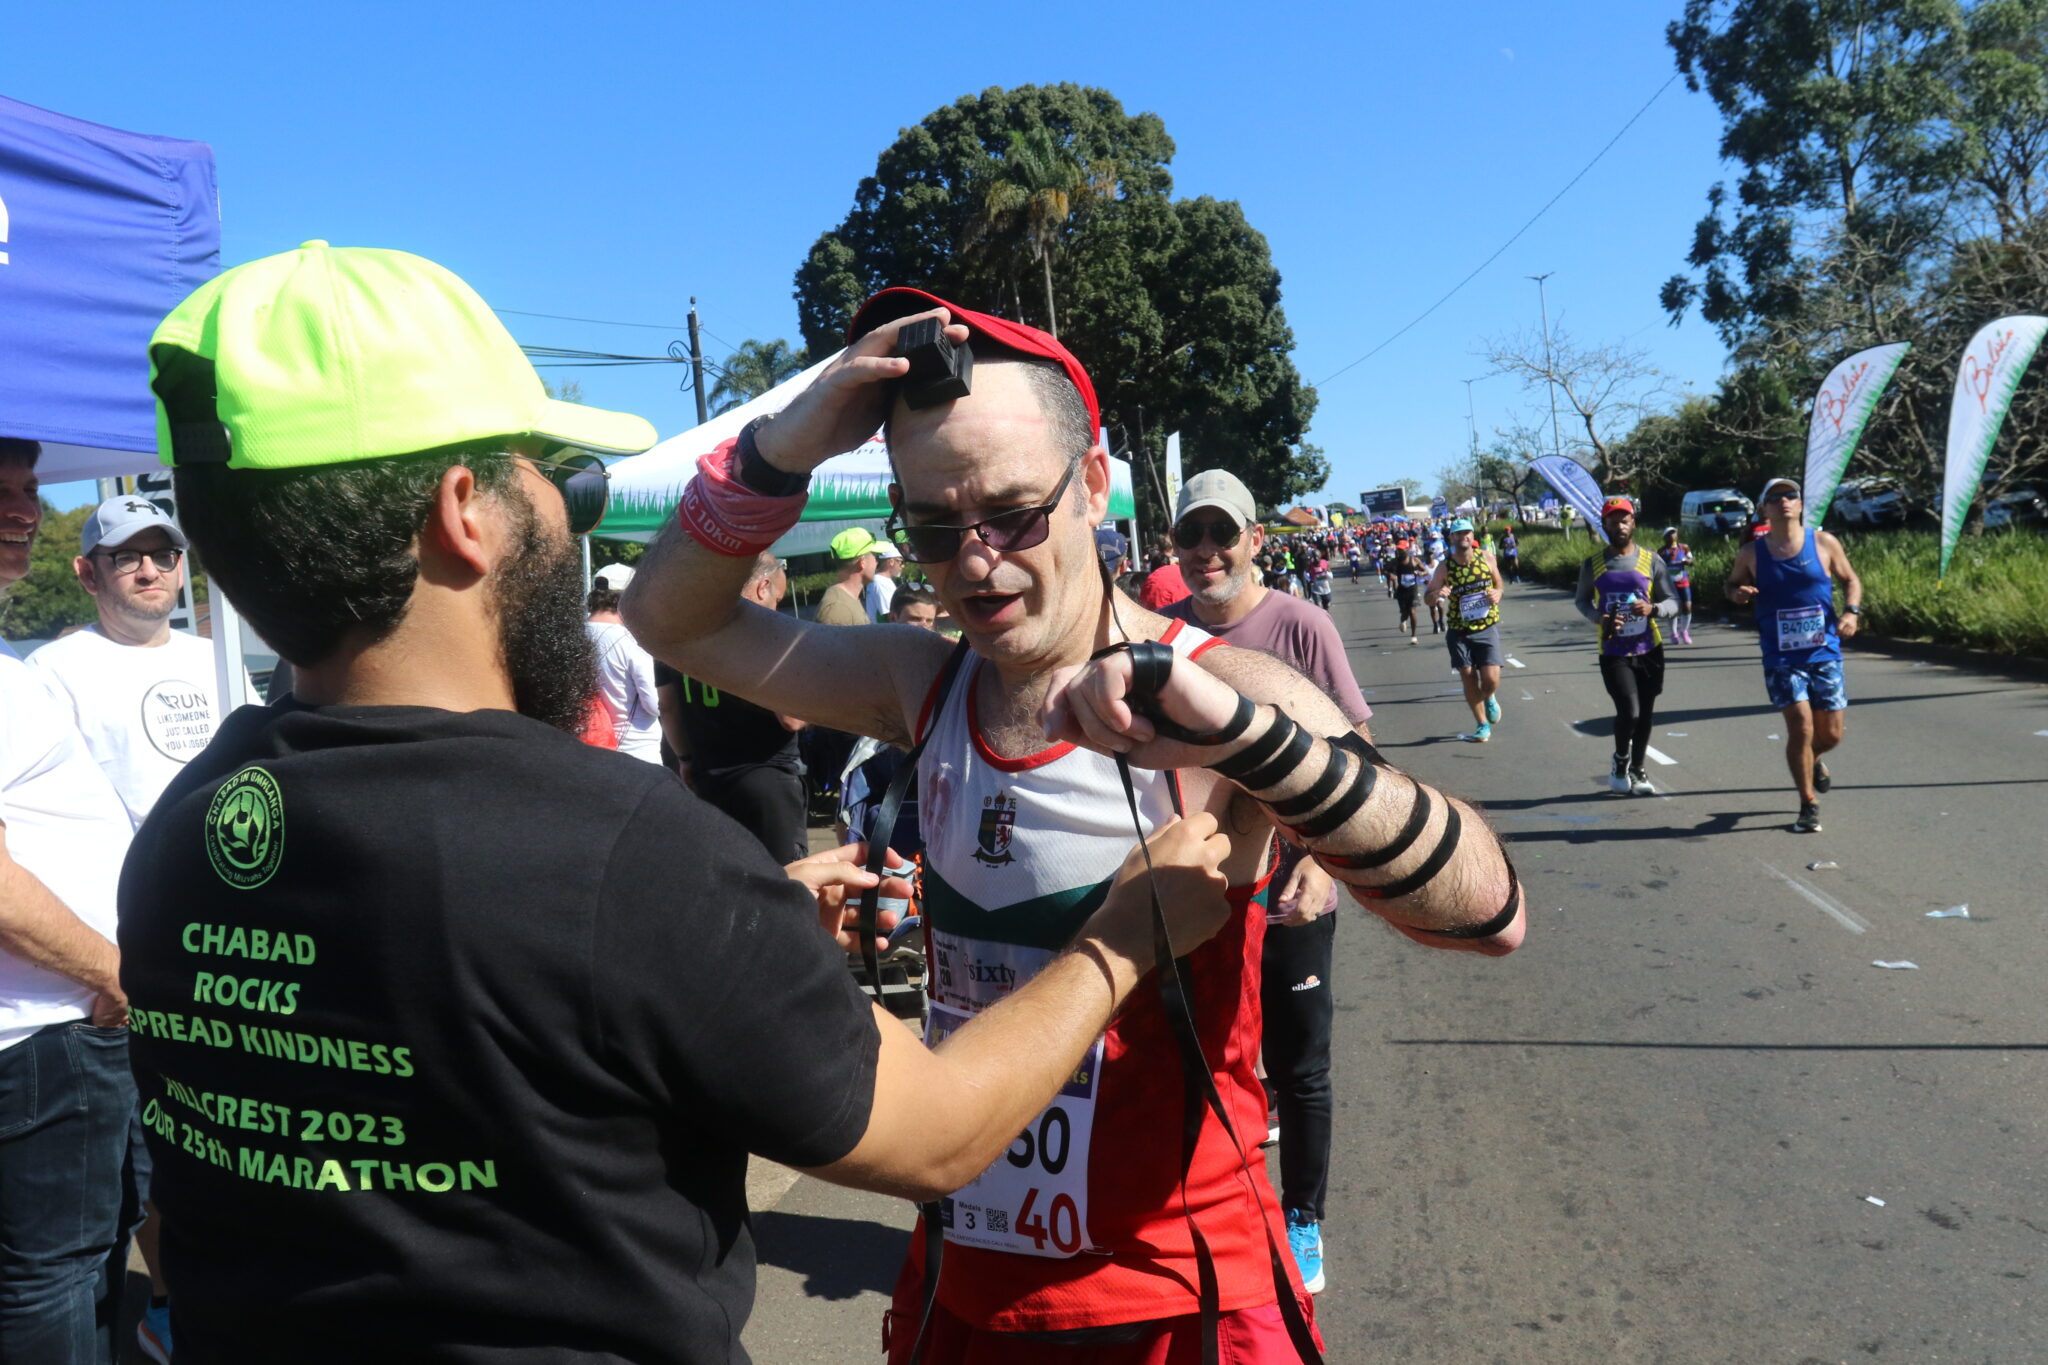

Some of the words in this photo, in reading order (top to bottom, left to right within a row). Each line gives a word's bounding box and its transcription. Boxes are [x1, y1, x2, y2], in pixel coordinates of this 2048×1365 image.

[157, 712, 174, 724] LIKE
[174, 709, 211, 723] SOMEONE
[165, 726, 181, 738] JUS
[182, 723, 209, 736] CALLED
[209, 777, 239, 825] CHABAD
[240, 771, 250, 781] IN
[250, 771, 281, 830] UMHLANGA
[182, 922, 316, 966] CHABAD
[194, 971, 300, 1015] ROCKS
[128, 1005, 233, 1048] SPREAD
[239, 1024, 414, 1077] KINDNESS
[142, 1098, 176, 1145] OUR
[181, 1123, 233, 1171] 25th
[239, 1147, 498, 1193] MARATHON
[300, 1110, 405, 1146] 2023
[958, 1201, 982, 1212] Medals
[965, 1213, 976, 1230] 3
[1015, 1188, 1082, 1253] 40
